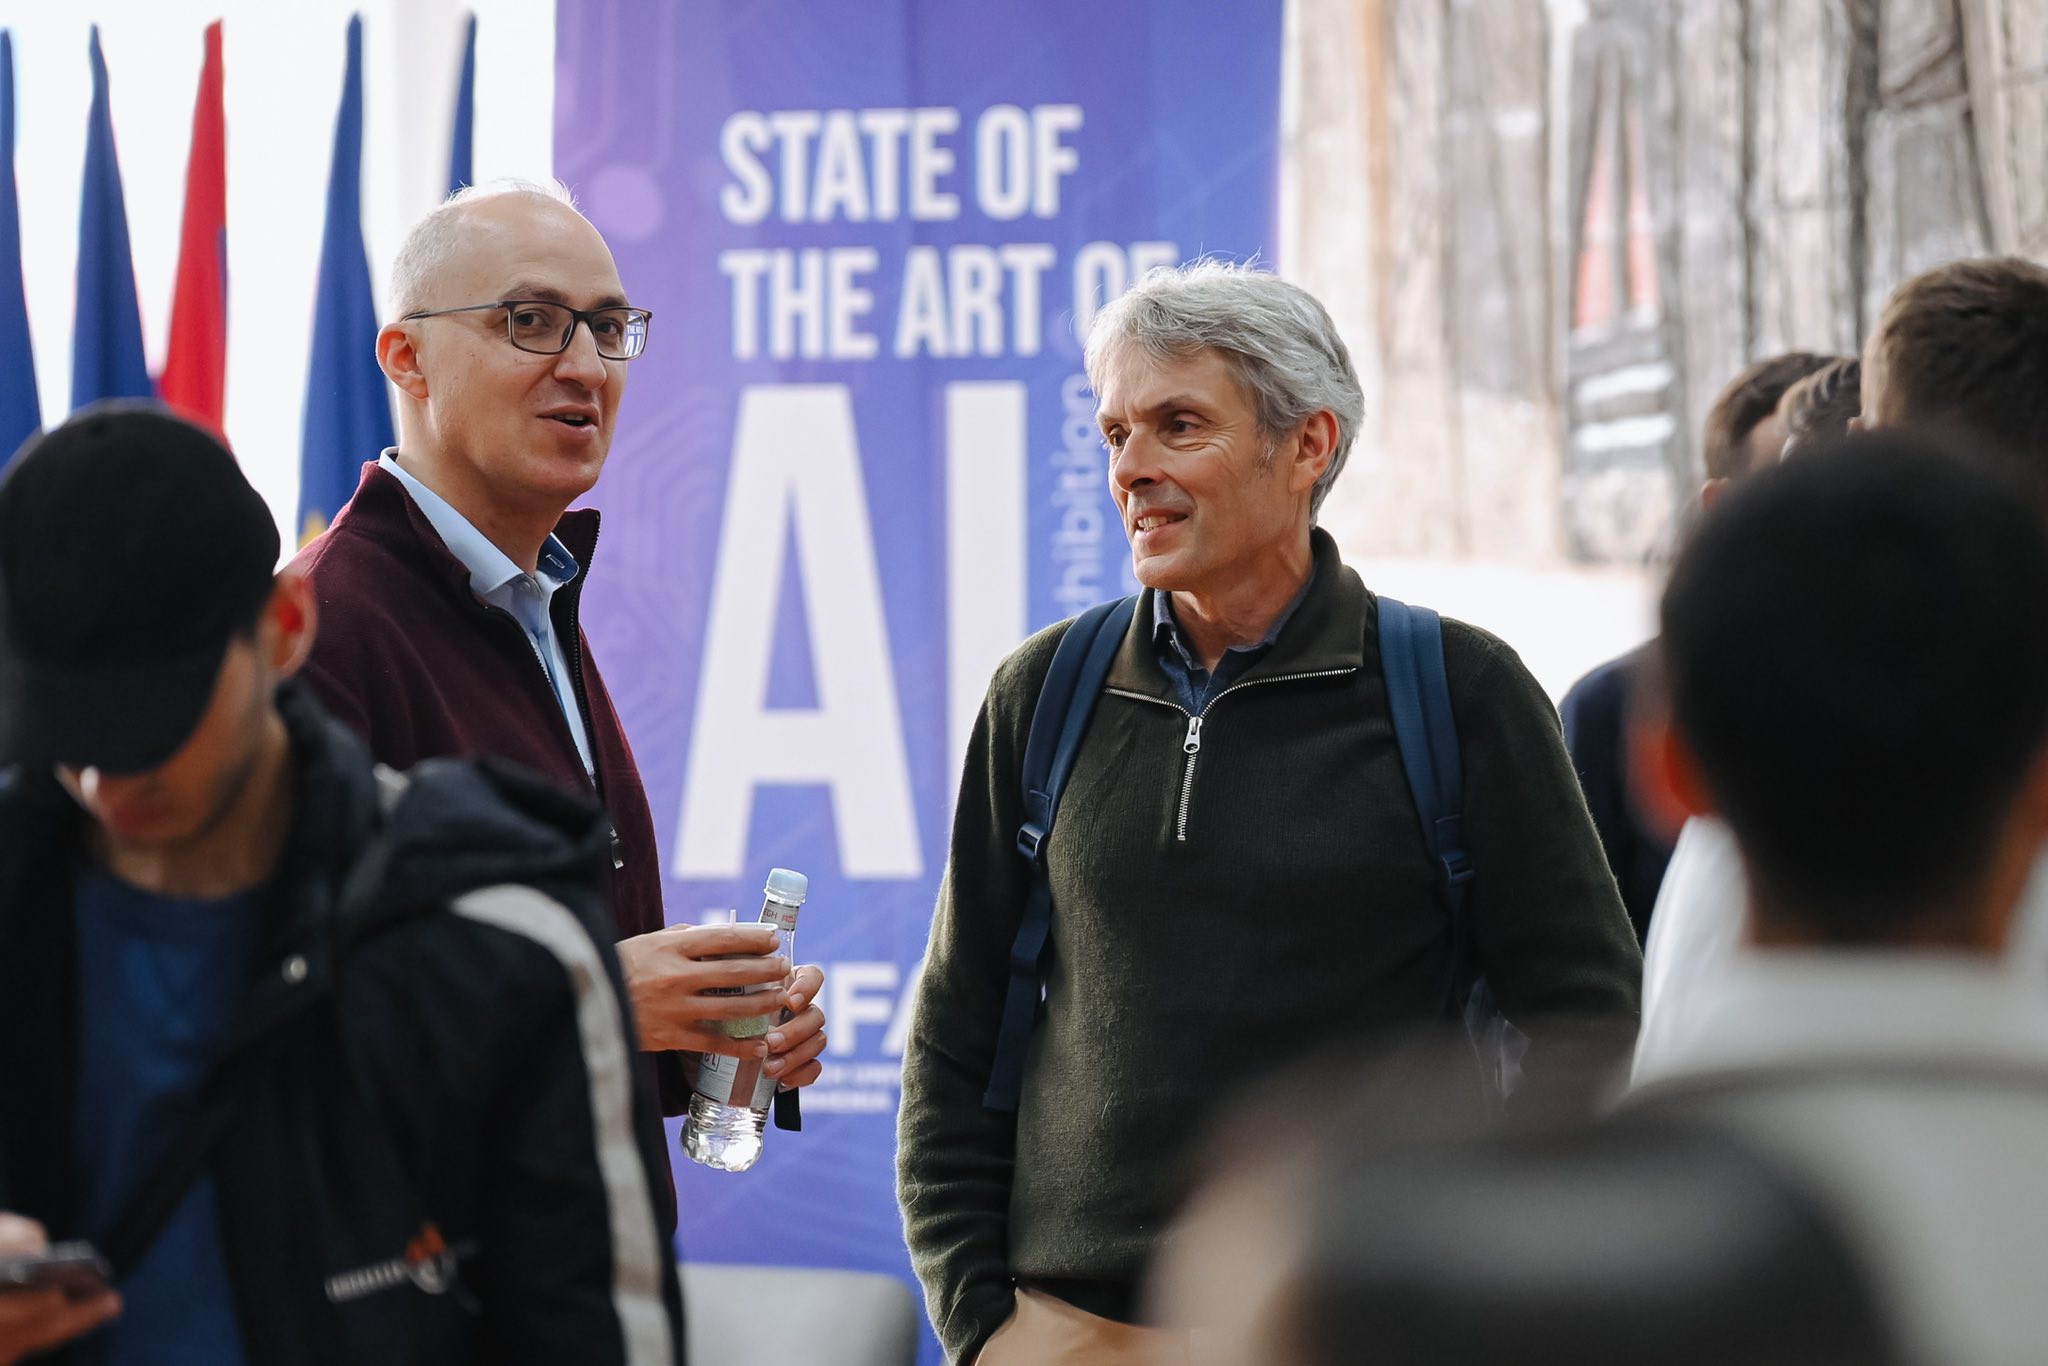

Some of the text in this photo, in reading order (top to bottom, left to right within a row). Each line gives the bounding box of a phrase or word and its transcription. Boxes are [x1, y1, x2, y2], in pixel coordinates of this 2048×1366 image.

[720, 105, 1082, 225] STATE OF
[718, 247, 878, 363] THE
[894, 245, 1055, 358] ART
[672, 382, 1028, 881] AI
